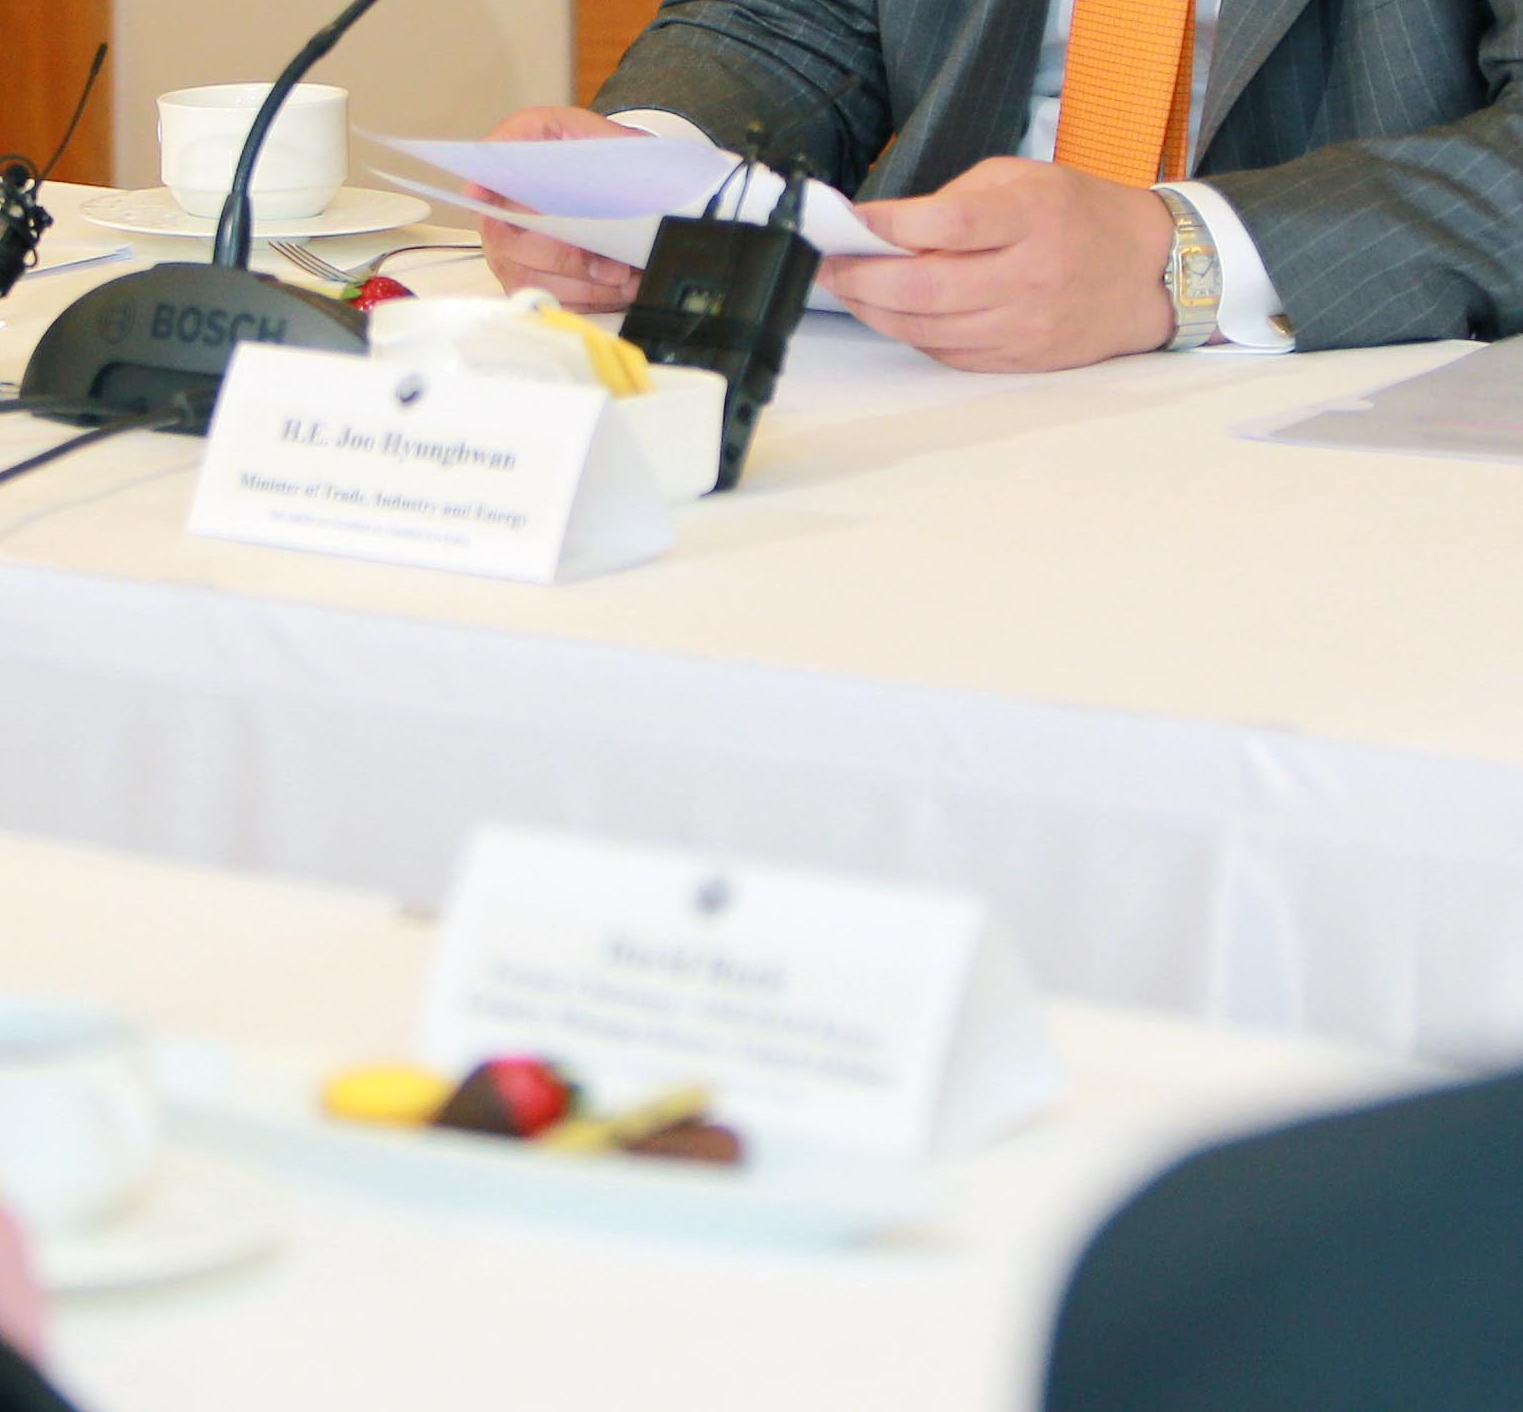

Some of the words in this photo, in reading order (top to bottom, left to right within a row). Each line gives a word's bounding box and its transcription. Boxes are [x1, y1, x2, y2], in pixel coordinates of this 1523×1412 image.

[150, 302, 290, 346] BOSCH
[280, 417, 328, 446] H.E.
[335, 425, 376, 453] Joo
[380, 431, 518, 472] Hyunghwan
[239, 470, 300, 496] Minister
[303, 482, 320, 500] of
[374, 490, 436, 518] Industry
[441, 501, 472, 519] and
[474, 502, 527, 531] Energy
